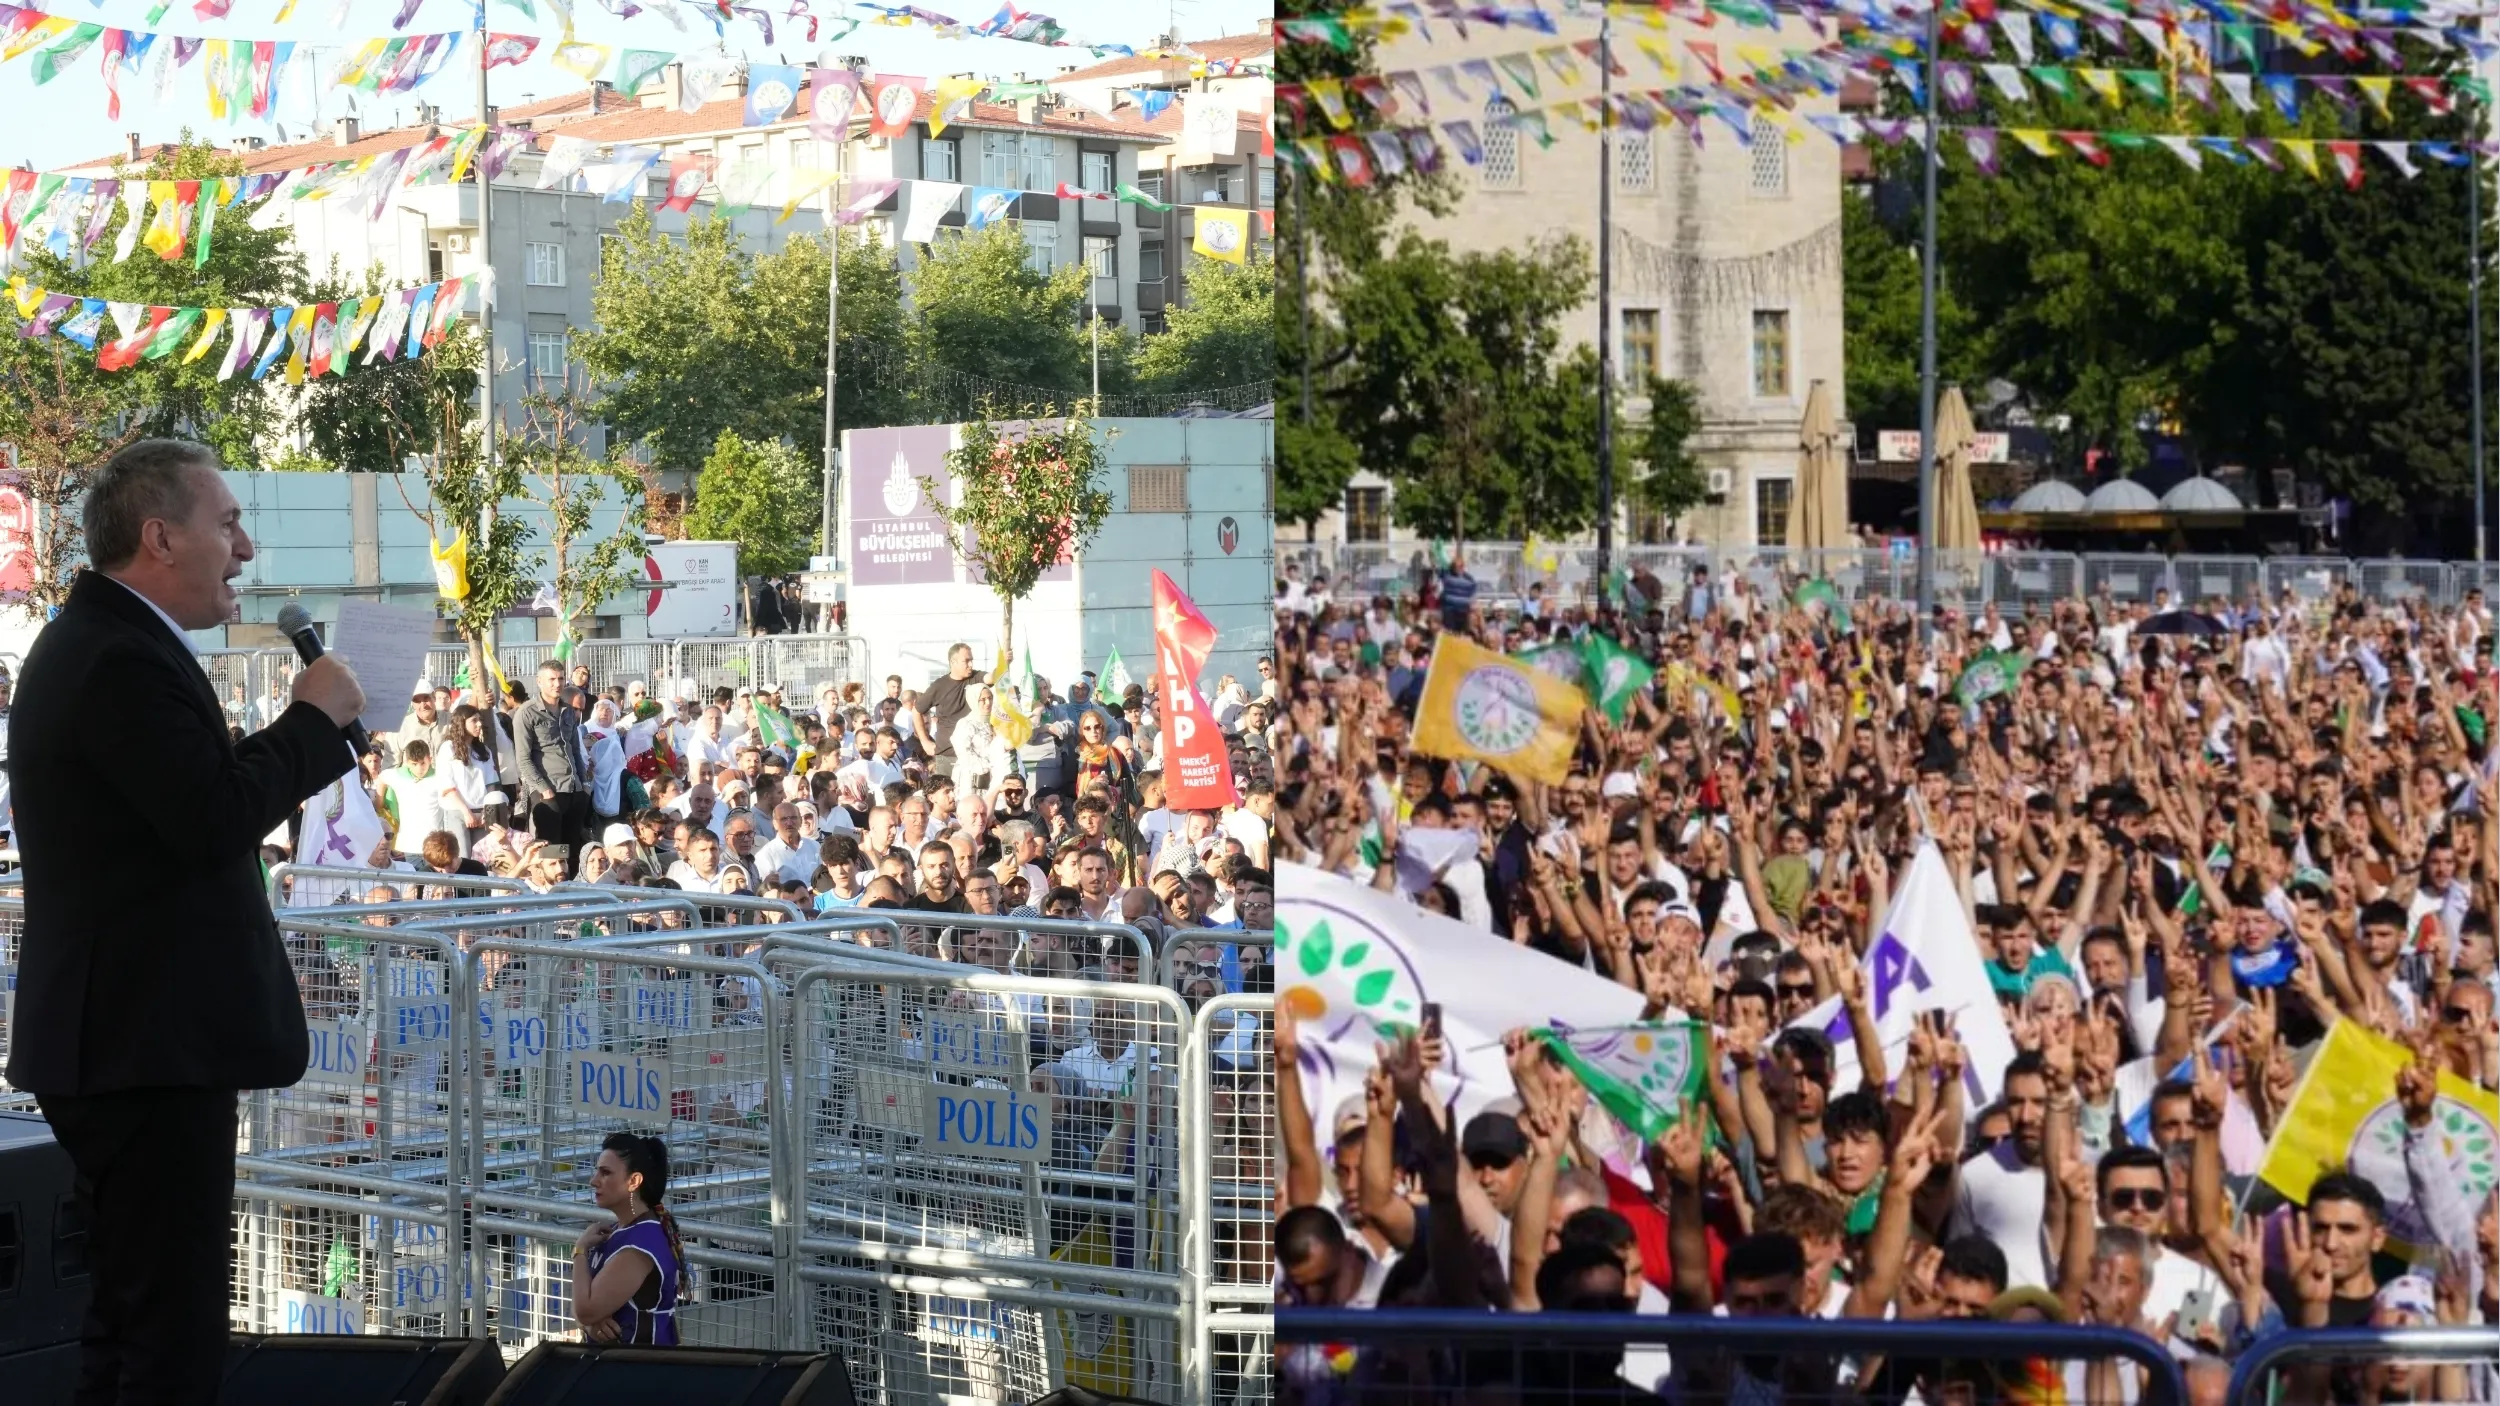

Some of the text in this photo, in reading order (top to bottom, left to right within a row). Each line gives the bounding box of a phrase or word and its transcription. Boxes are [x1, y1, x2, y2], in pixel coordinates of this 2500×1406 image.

[872, 521, 931, 533] İSTANBUL
[860, 532, 944, 551] BÜYÜKŞEHİR
[873, 551, 932, 563] BELEDİYESİ
[1179, 753, 1210, 768] EMEKÇİ
[1181, 763, 1220, 776] HAREKET
[1184, 774, 1217, 787] PARTİSİ
[637, 982, 694, 1030] POLİ
[307, 1024, 358, 1075] OLİS
[580, 1057, 661, 1112] POLİS
[937, 1092, 1039, 1149] POLİS
